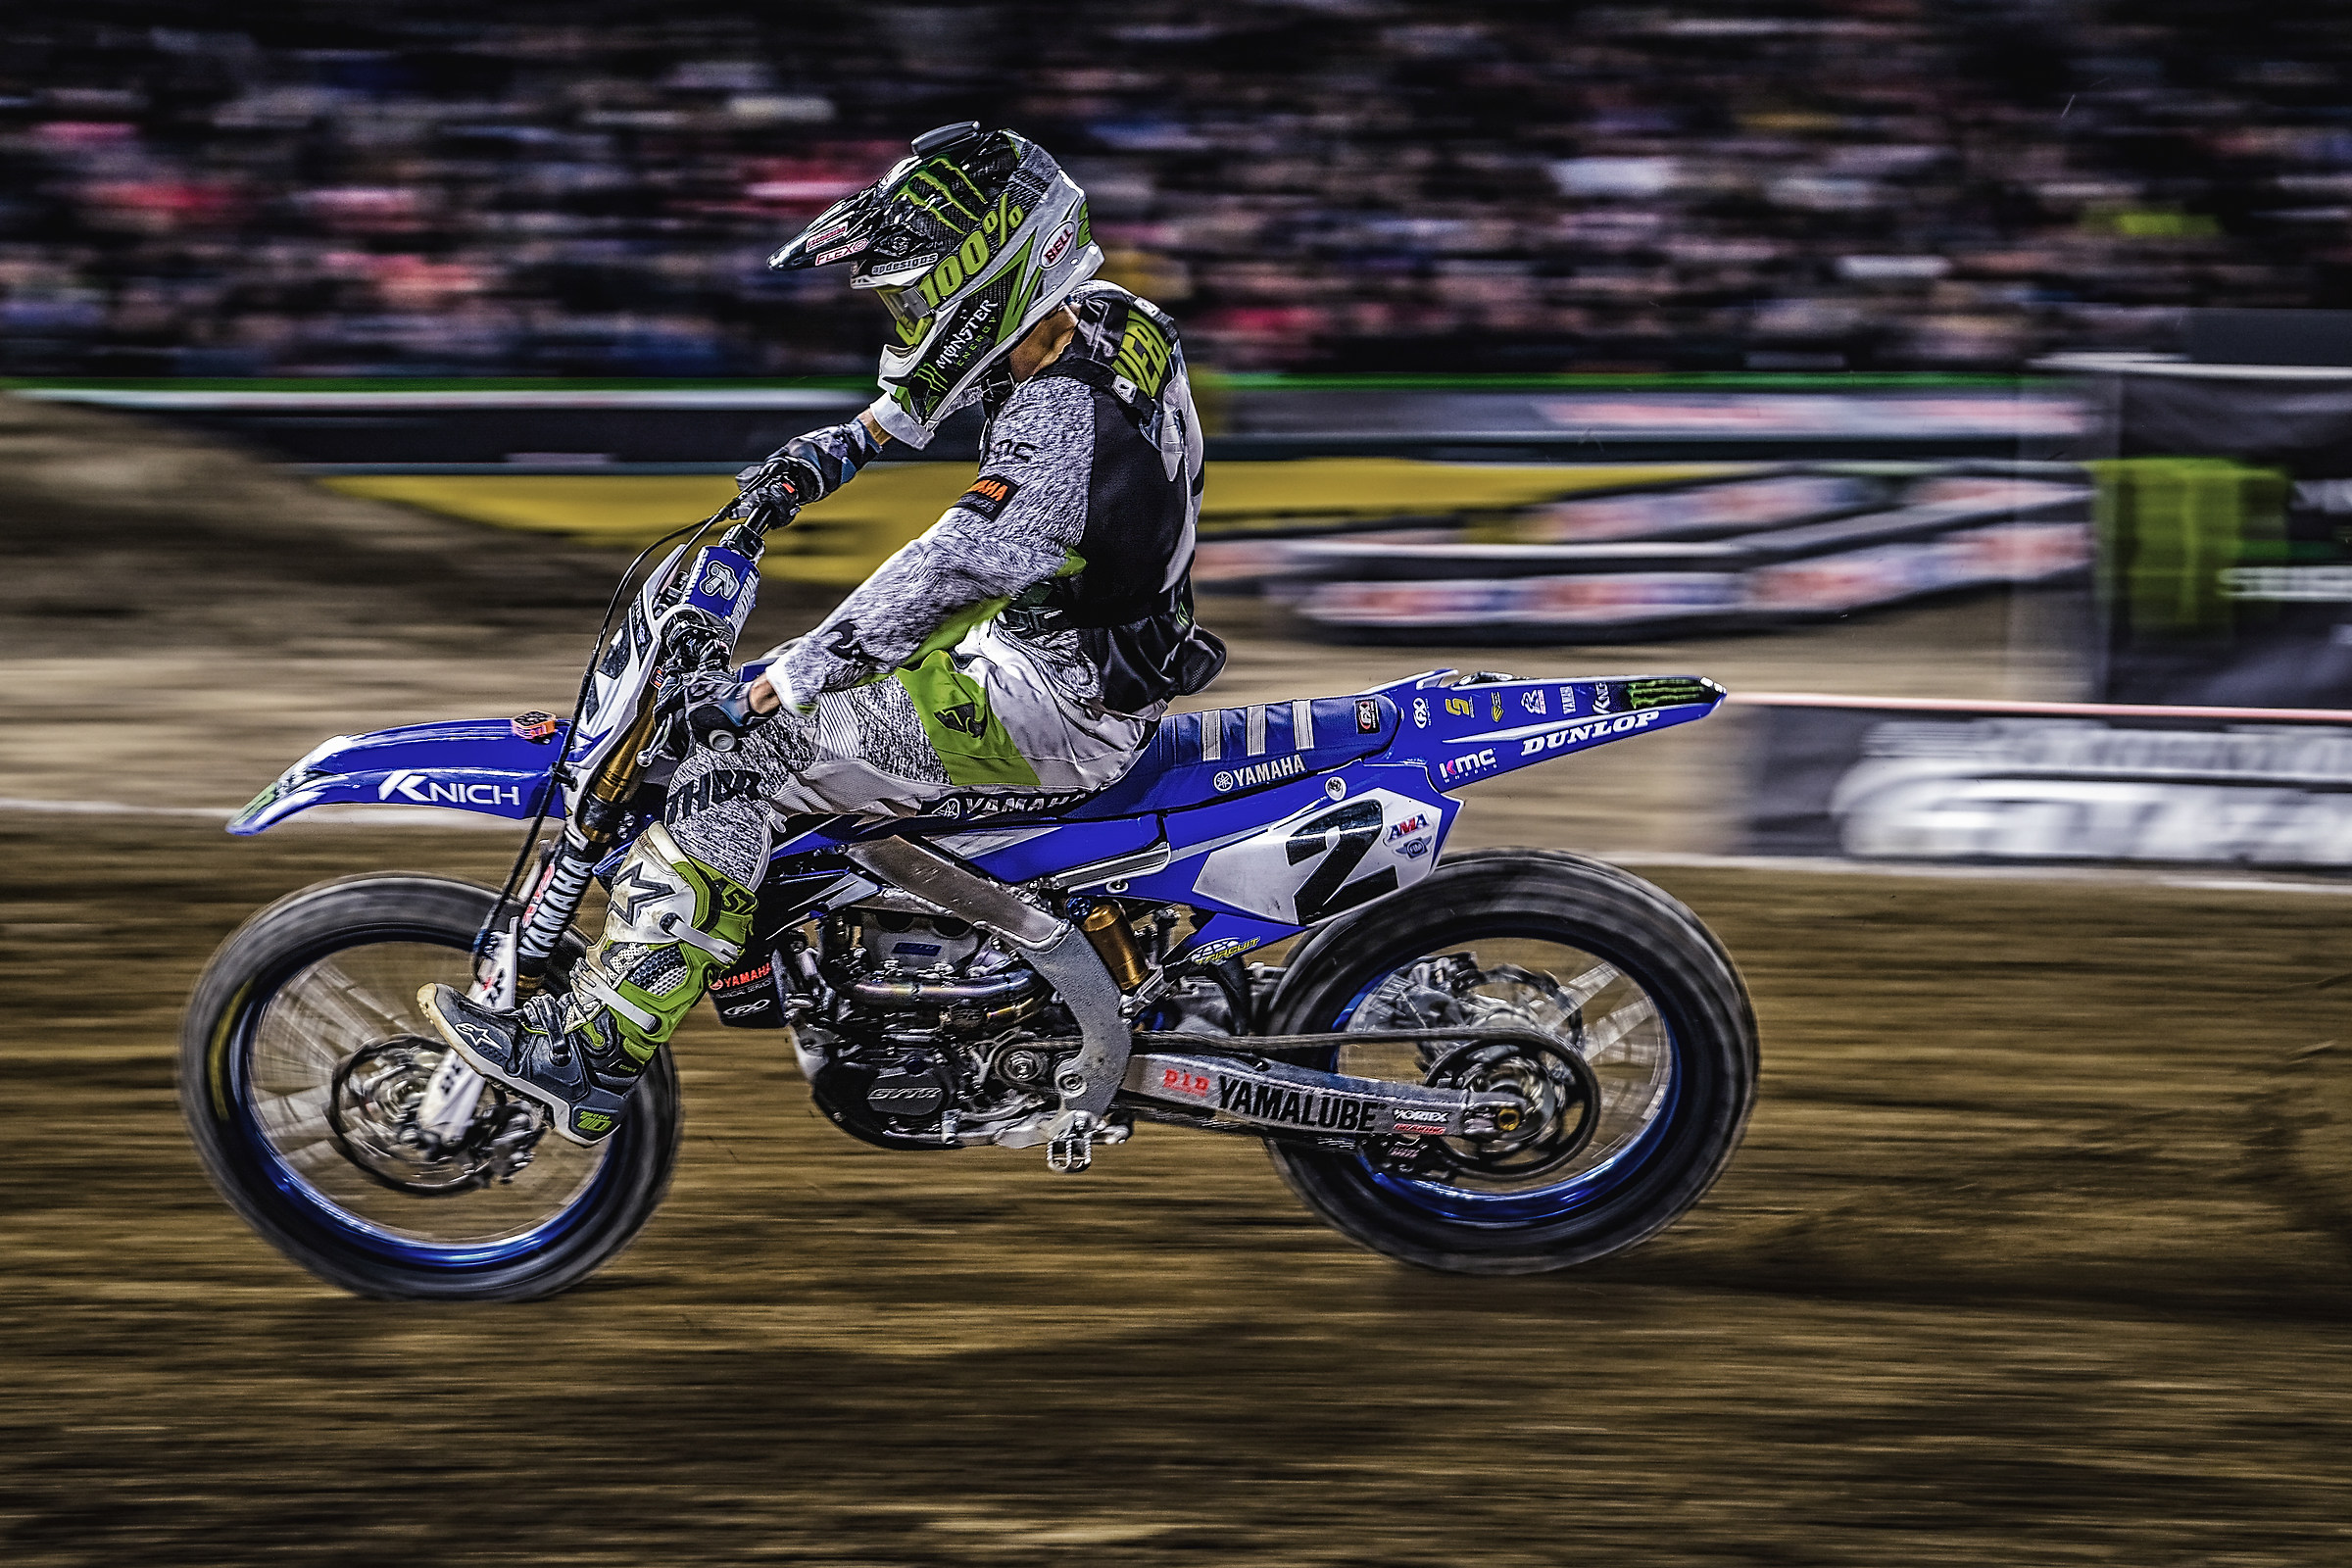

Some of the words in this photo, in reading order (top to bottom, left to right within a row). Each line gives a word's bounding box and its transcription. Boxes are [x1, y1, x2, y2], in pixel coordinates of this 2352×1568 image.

[917, 192, 1025, 308] 100%
[1043, 228, 1074, 265] BELL
[935, 299, 999, 369] MONSTER
[1520, 710, 1660, 757] DUNLOP
[378, 769, 521, 806] KNICH
[1233, 754, 1306, 787] YAMAHA
[1388, 813, 1429, 843] AMA
[1284, 798, 1399, 925] 2
[516, 855, 596, 958] YAMAHA
[1218, 1074, 1380, 1132] YAMALUBE
